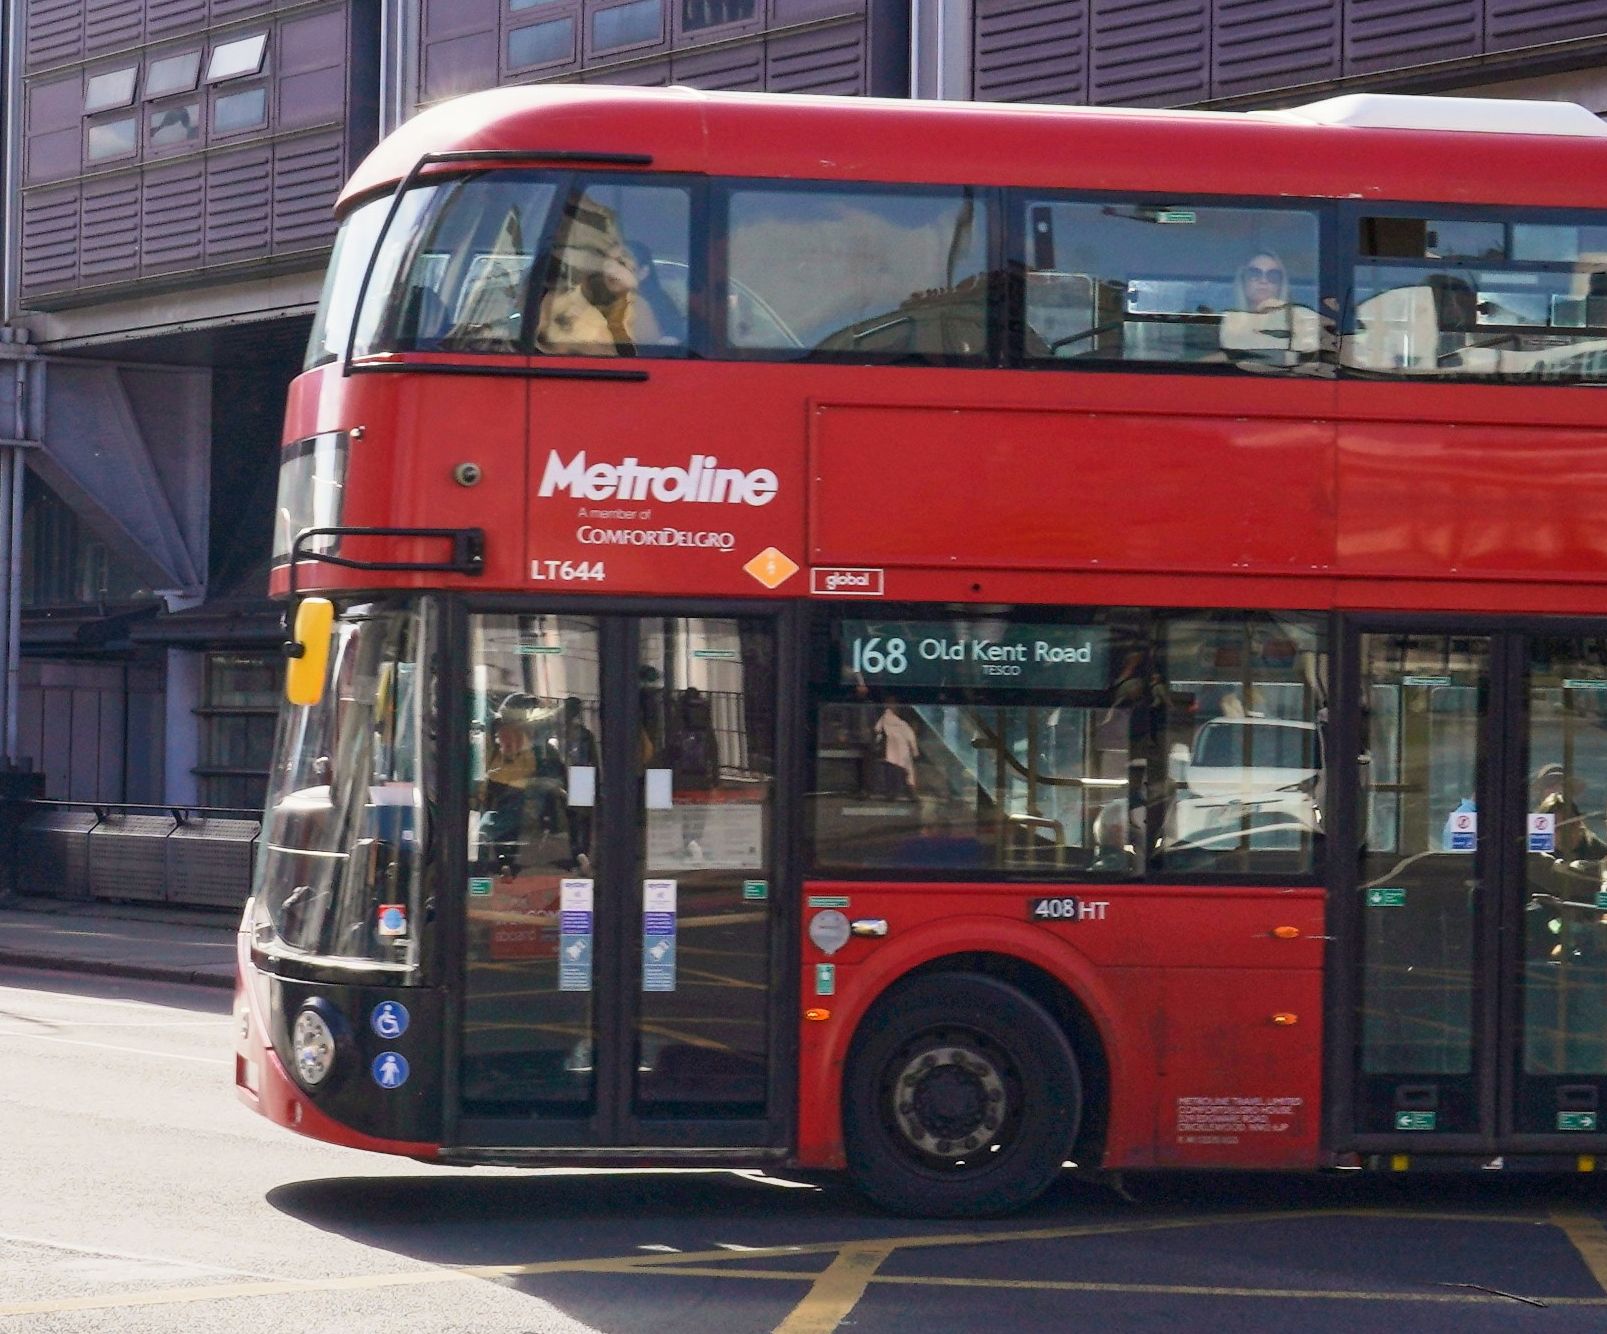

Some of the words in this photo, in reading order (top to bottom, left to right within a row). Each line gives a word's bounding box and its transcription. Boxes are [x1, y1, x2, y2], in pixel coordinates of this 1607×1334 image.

[537, 448, 779, 507] Metroline
[589, 508, 637, 520] member
[639, 508, 652, 520] of
[530, 560, 606, 582] LT644
[825, 572, 870, 590] global
[853, 637, 908, 674] 168
[918, 638, 966, 660] Old
[971, 639, 1028, 662] Kent
[1034, 640, 1092, 663] Road
[982, 664, 1022, 676] TESCO
[1035, 899, 1075, 918] 408
[1078, 901, 1110, 920] HT
